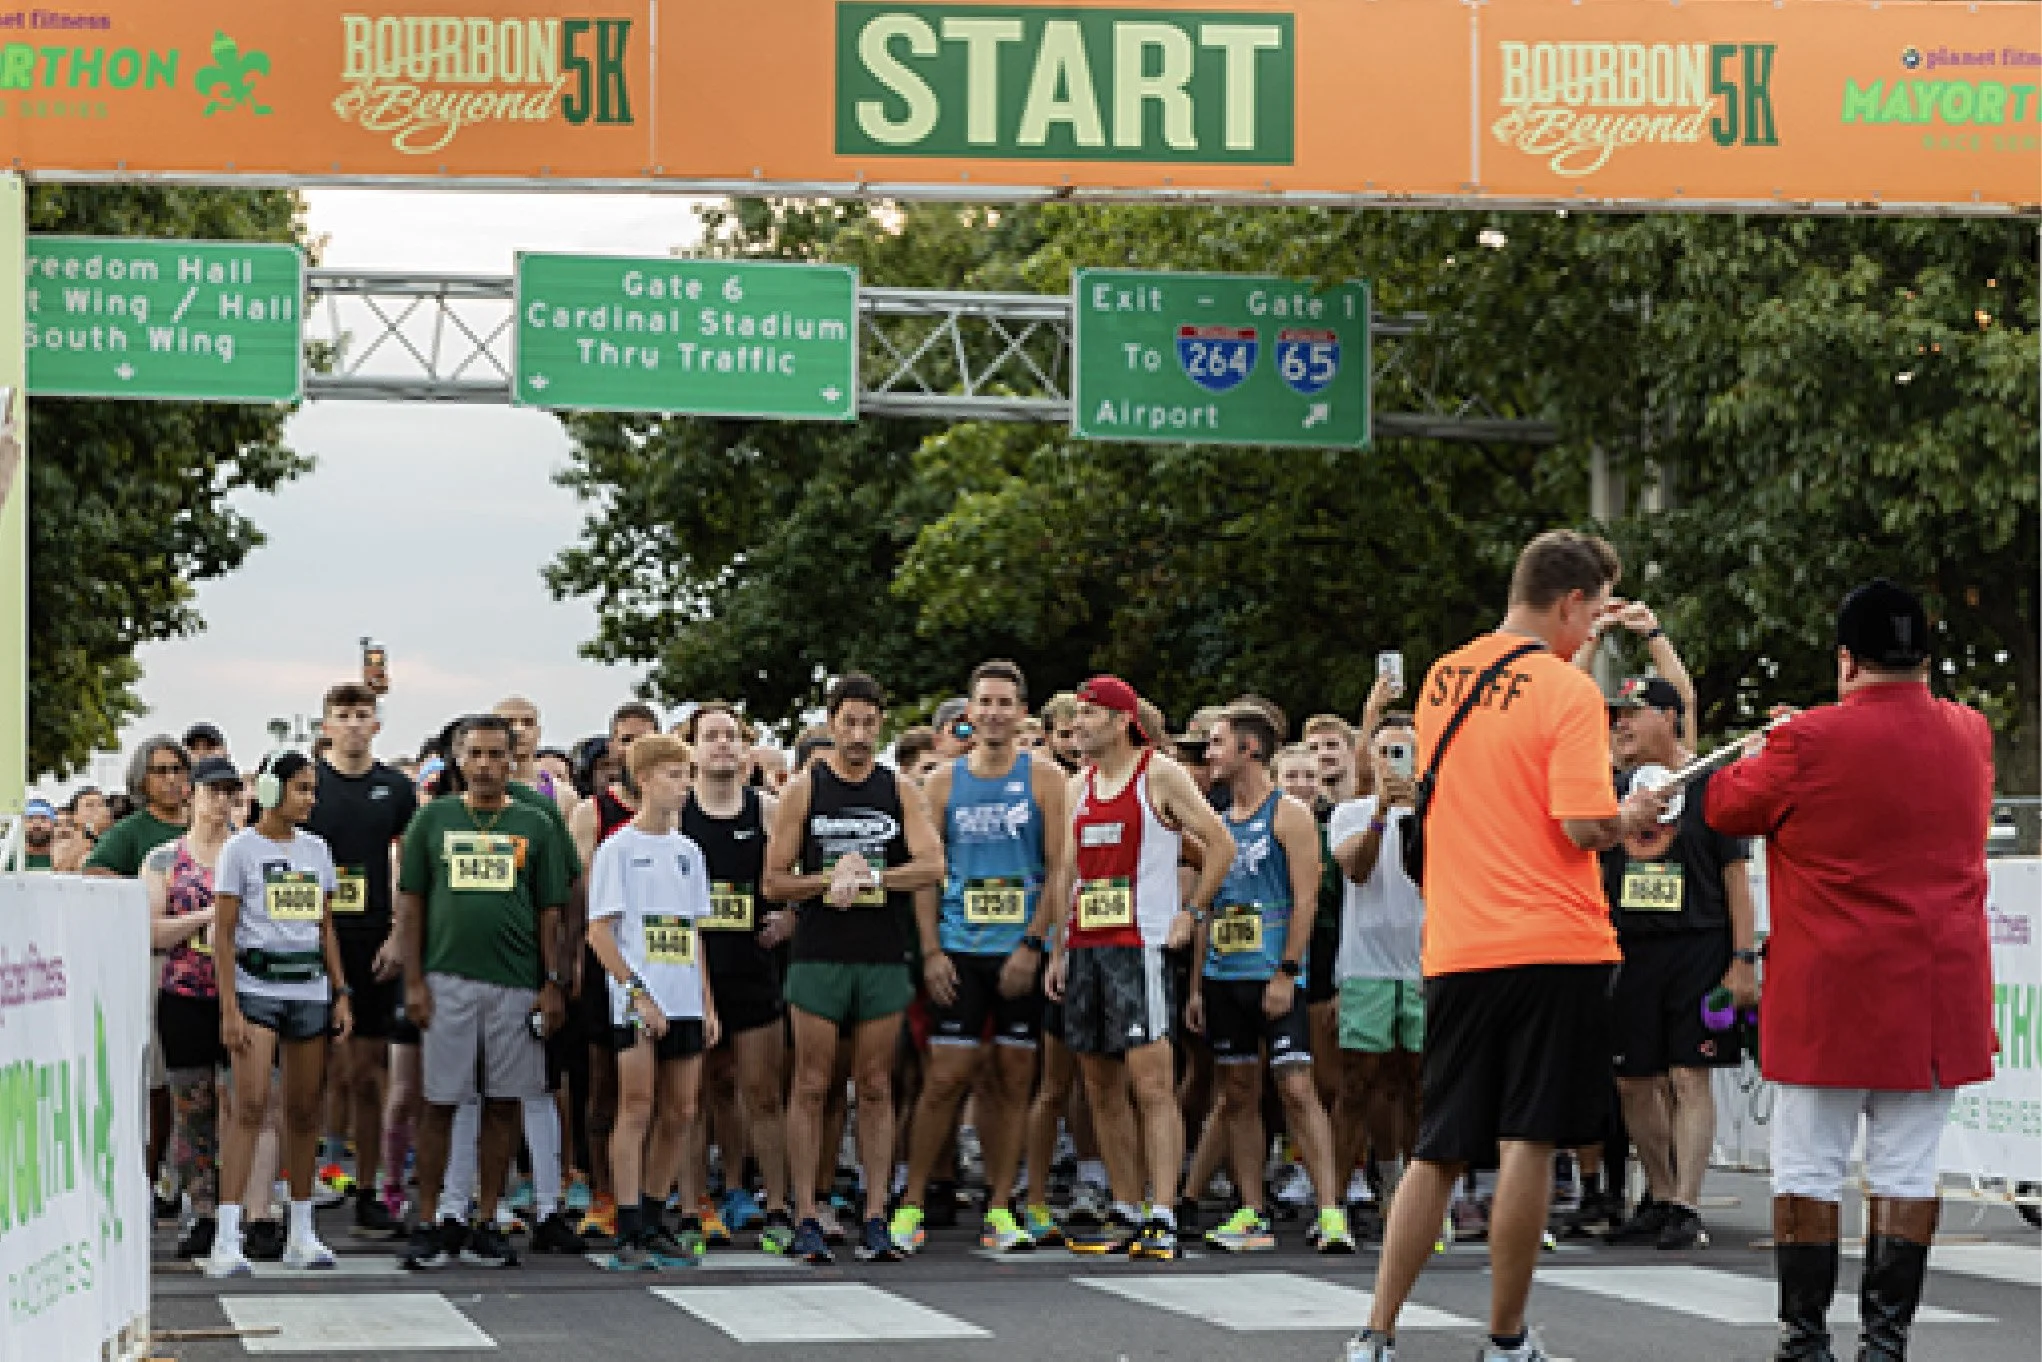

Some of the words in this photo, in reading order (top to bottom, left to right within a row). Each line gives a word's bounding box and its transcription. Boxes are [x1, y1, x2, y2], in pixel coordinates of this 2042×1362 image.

[0, 43, 180, 90] RTHON
[341, 15, 559, 83] BOURBON
[560, 18, 634, 126] 5K
[1926, 45, 1996, 70] planet
[855, 12, 1282, 151] START
[1500, 41, 1709, 107] BOURBON
[1710, 45, 1780, 147] 5K
[360, 74, 566, 154] Beyond
[1841, 78, 2042, 126] MAYORT
[1519, 98, 1716, 178] Beyond
[177, 255, 252, 283] Hall
[622, 270, 703, 300] Gate
[722, 274, 743, 303] 6
[64, 287, 150, 324] Wing
[170, 286, 200, 324] /
[218, 291, 292, 320] Hall
[526, 300, 680, 333] Cardinal
[700, 306, 848, 340] Stadium
[1092, 283, 1163, 312] Exit
[1246, 290, 1324, 319] Gate
[1342, 294, 1355, 320] 1
[147, 326, 236, 363] Wing
[576, 338, 660, 370] Thru
[677, 342, 797, 377] Traffic
[1122, 342, 1161, 372] To
[1188, 342, 1247, 377] 264
[1279, 342, 1337, 382] 65
[1094, 399, 1219, 430] Airport
[1429, 665, 1533, 711] STFF
